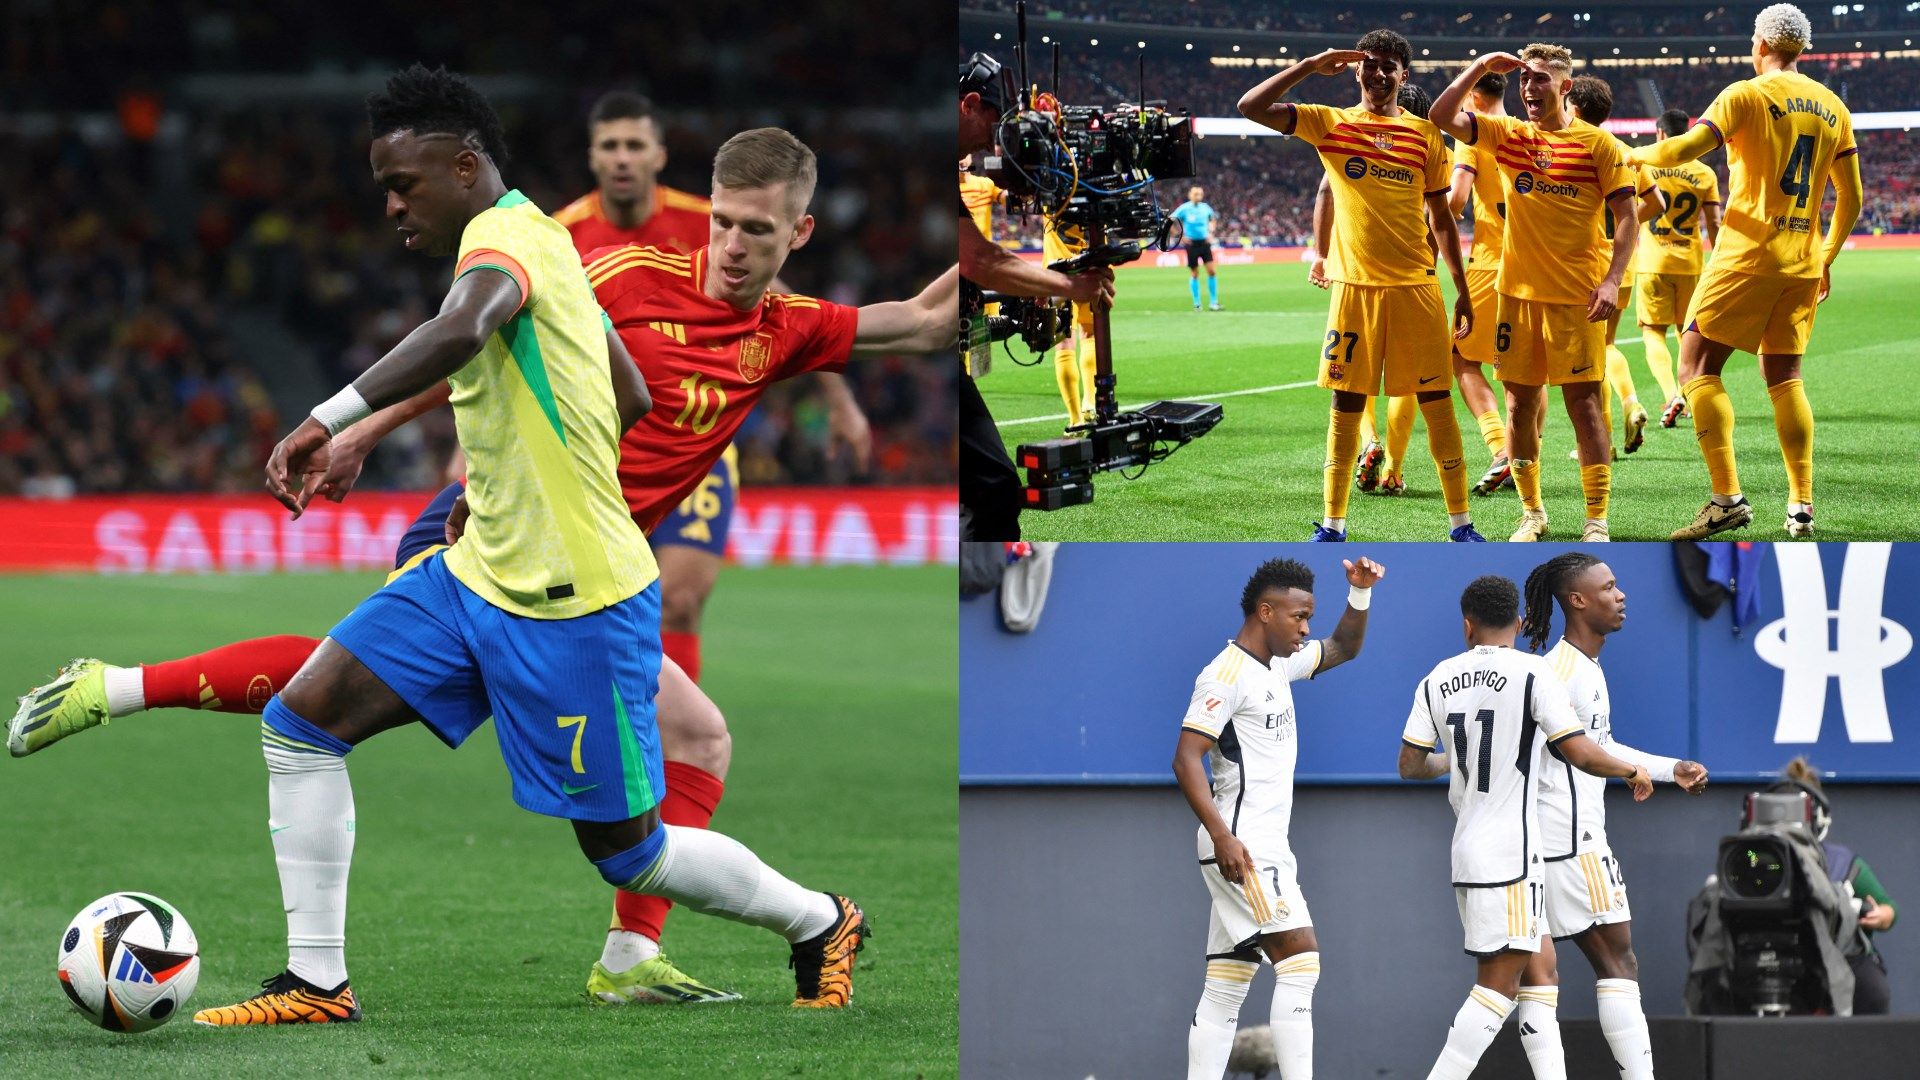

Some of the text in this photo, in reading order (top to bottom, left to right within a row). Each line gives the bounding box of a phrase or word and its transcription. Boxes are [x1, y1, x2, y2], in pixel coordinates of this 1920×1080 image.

[1768, 98, 1837, 129] R. ARAUJO
[1370, 164, 1414, 185] Spotify
[1780, 134, 1815, 208] 4
[1534, 180, 1579, 199] Spotify
[1649, 186, 1698, 236] 22
[1324, 329, 1359, 363] 27
[1496, 322, 1512, 353] 6
[673, 371, 728, 435] 10
[1440, 669, 1508, 699] RODRYGO
[557, 715, 588, 774] 7
[1445, 708, 1495, 794] 11
[1263, 865, 1282, 897] 7
